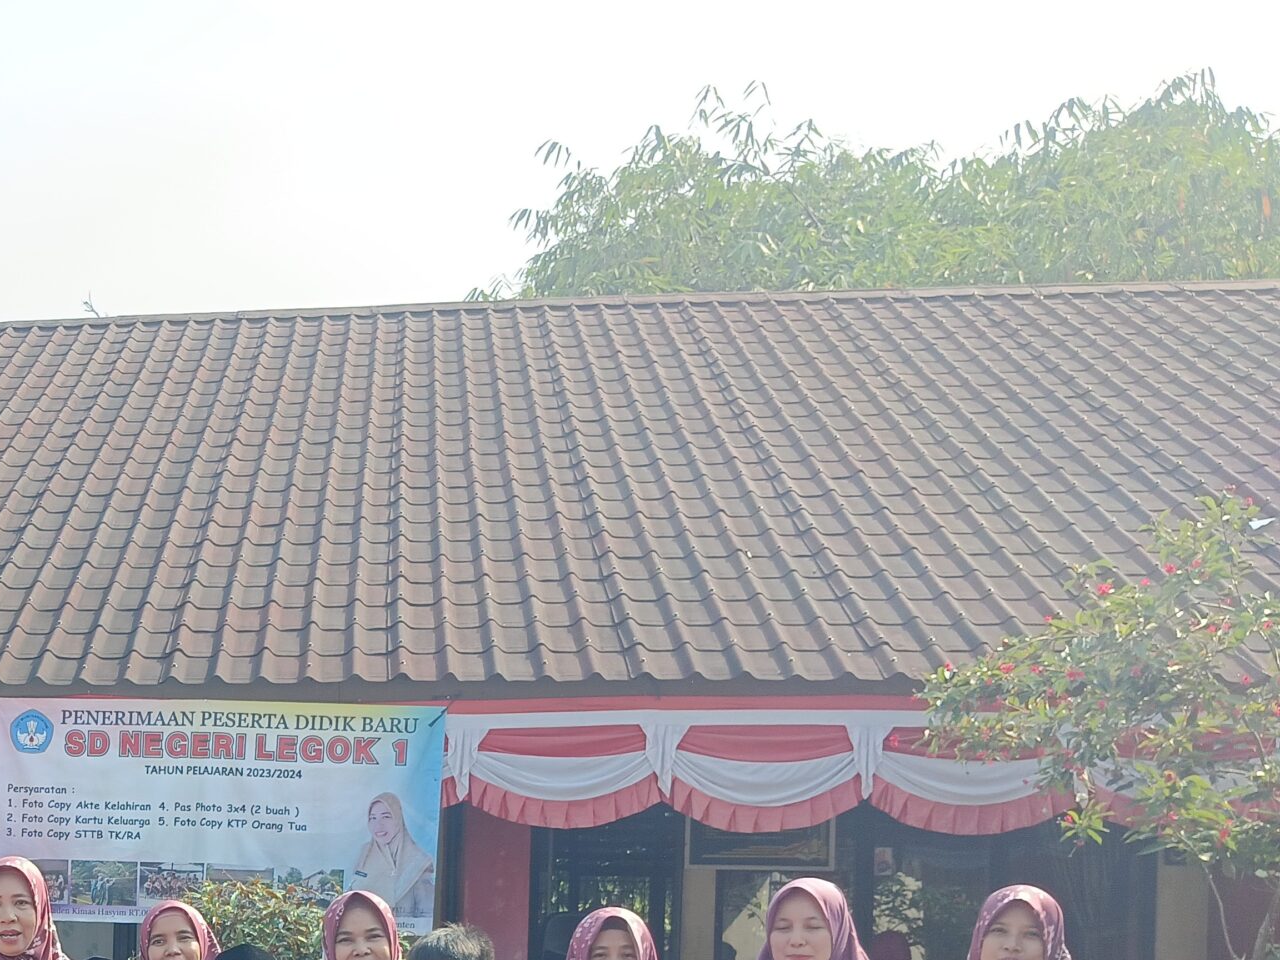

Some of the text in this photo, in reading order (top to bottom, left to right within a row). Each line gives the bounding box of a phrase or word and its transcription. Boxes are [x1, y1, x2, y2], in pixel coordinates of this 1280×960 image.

[61, 709, 196, 727] PENERIMAAN
[201, 711, 289, 730] PESERTA
[295, 715, 357, 732] DIDIK
[361, 716, 419, 734] BARU
[64, 729, 408, 766] SD NEGERI LEGOK 1
[145, 765, 303, 779] TAHUN PELAJARAN 2023/2024
[7, 784, 67, 795] Persyaratan
[8, 799, 151, 811] 1. Foto Copy Akte Kelahiran
[159, 802, 169, 812] 4.
[174, 803, 191, 812] Pas
[195, 803, 222, 813] Photo
[227, 804, 246, 814] 3x4
[250, 804, 261, 816] (2
[266, 806, 290, 816] buah
[7, 813, 151, 827] 2. Foto Copy Kartu Keluarga
[158, 817, 307, 832] 5. Foto Copy KTP Orang Tua
[6, 828, 141, 840] 3. Foto Copy STTB TK/RA
